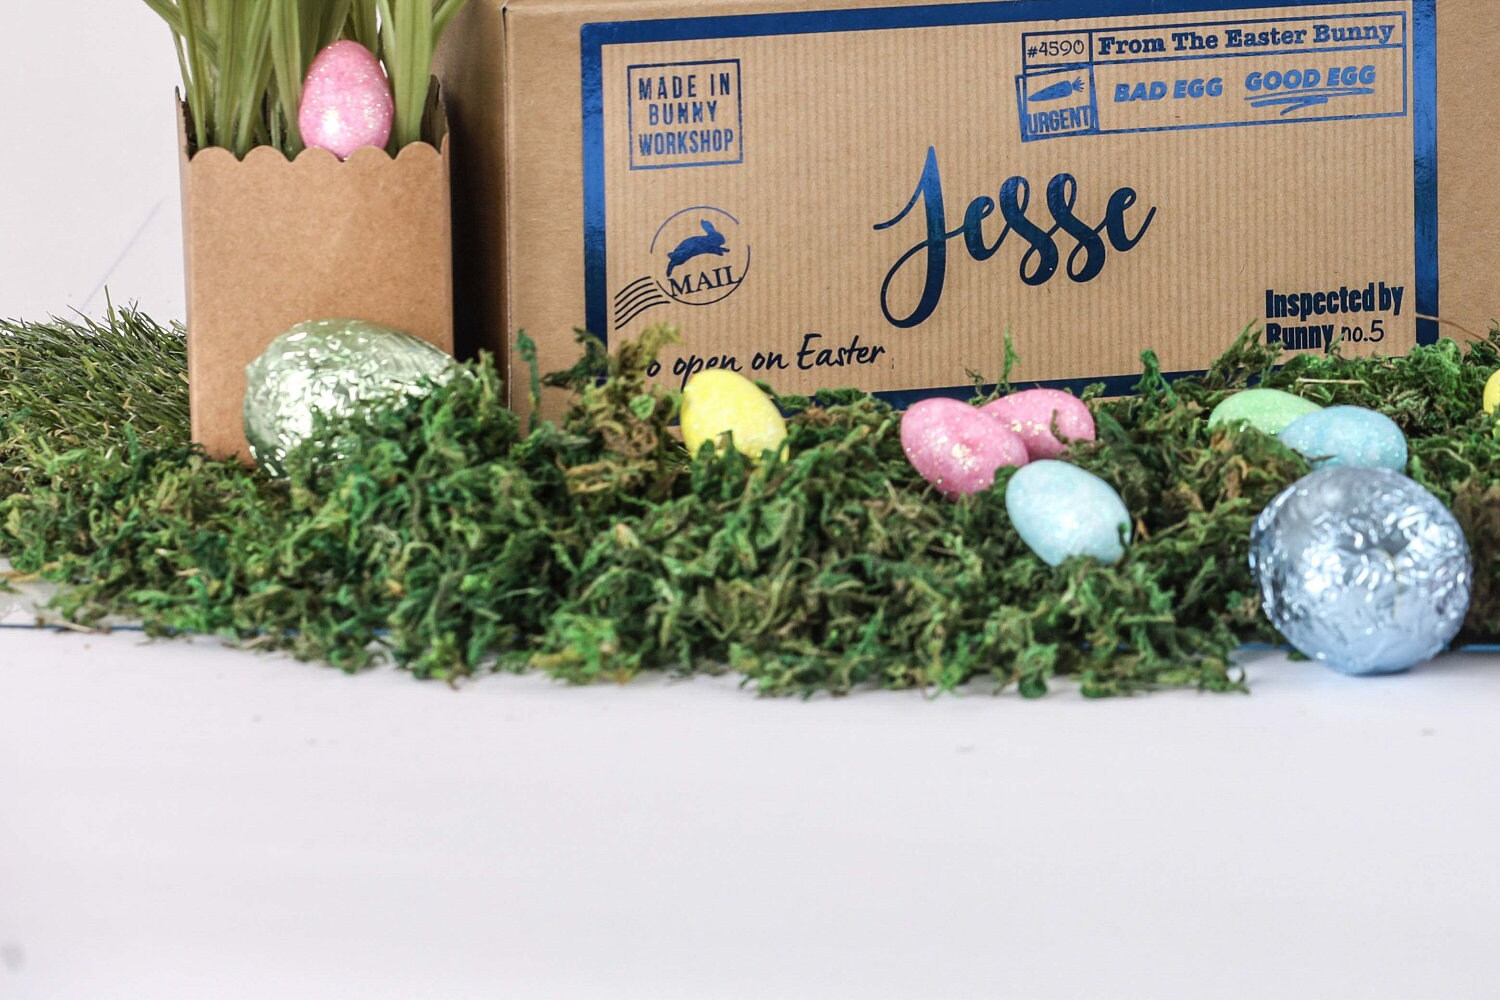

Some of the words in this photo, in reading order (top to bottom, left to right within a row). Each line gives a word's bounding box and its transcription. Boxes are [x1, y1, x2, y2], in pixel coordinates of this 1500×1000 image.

[1027, 39, 1085, 58] #4590
[1098, 35, 1166, 55] From
[1171, 30, 1219, 50] The
[1224, 27, 1307, 47] Easter
[1312, 23, 1395, 45] Bunny
[638, 75, 697, 100] MADE
[711, 73, 730, 96] IN
[1114, 82, 1167, 103] BAD
[1173, 78, 1223, 99] EGG
[1245, 69, 1322, 91] GOOD
[1326, 65, 1376, 86] EGG
[649, 100, 717, 126] BUNNY
[1026, 105, 1090, 134] URGENT
[638, 128, 734, 156] WORKSHOP
[872, 145, 1157, 329] Jesse
[667, 265, 742, 297] MAIL
[1266, 282, 1375, 321] Inspected
[1379, 282, 1404, 315] by
[1266, 323, 1334, 354] Bunny
[1341, 320, 1385, 342] no.5
[673, 354, 742, 393] open
[752, 351, 789, 370] on
[797, 333, 886, 370] Easter
